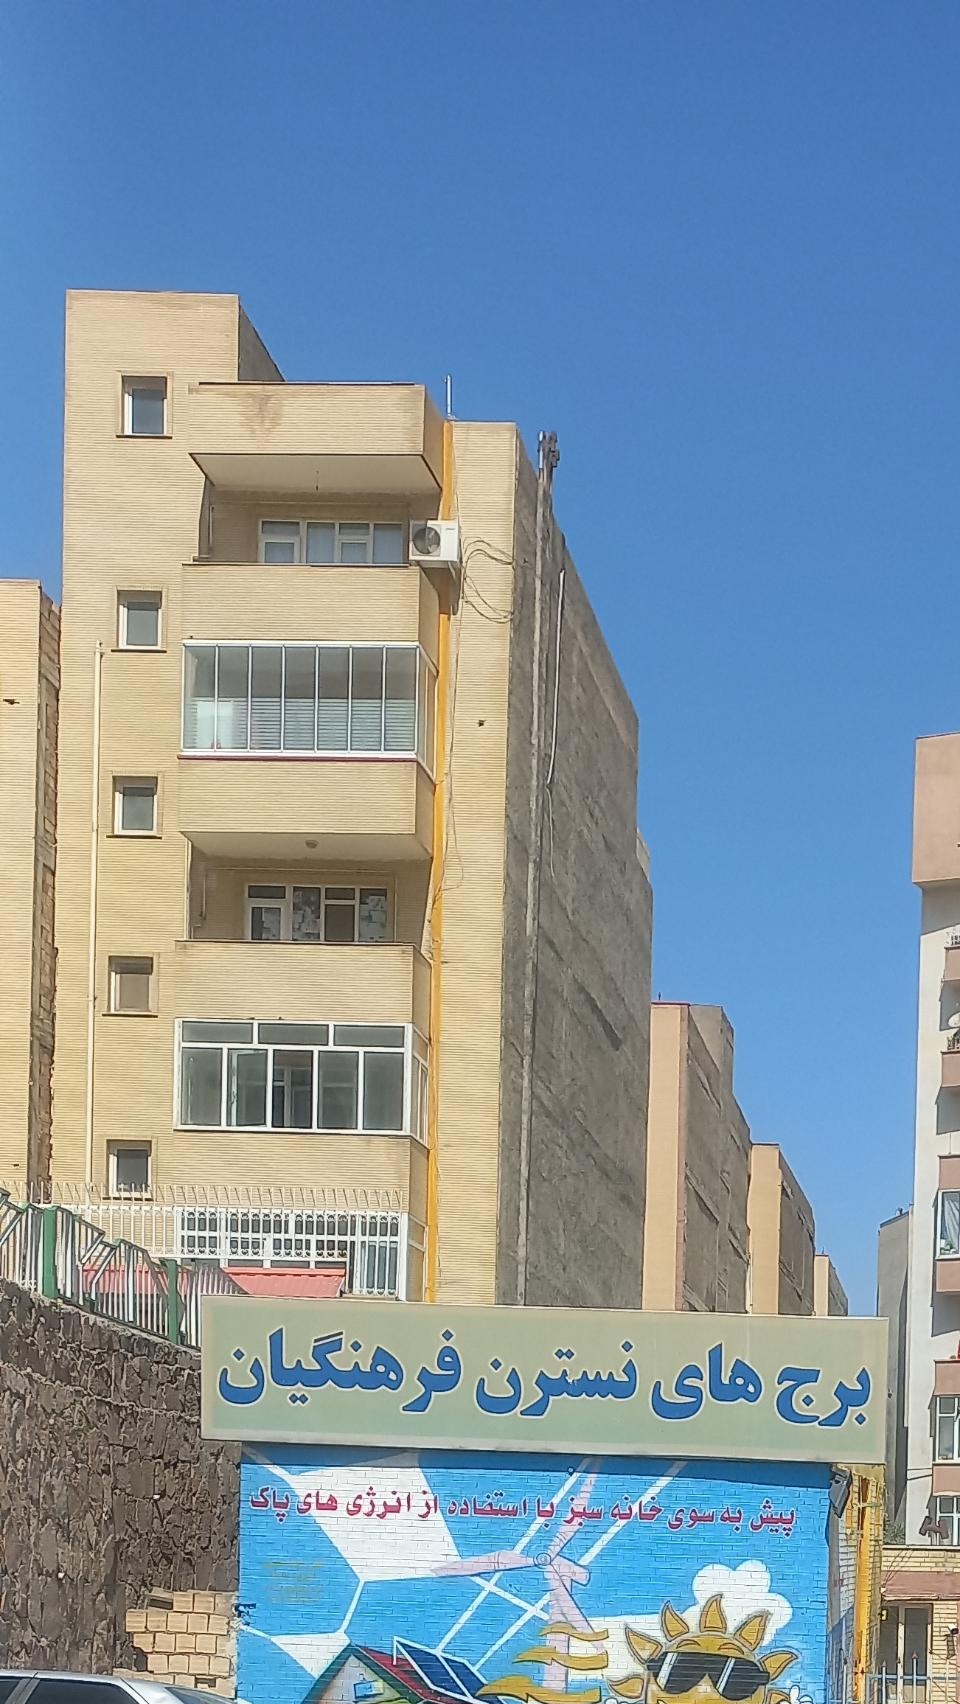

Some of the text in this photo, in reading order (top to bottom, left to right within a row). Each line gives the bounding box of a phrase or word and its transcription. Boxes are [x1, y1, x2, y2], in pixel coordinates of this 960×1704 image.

[217, 1328, 872, 1427] برج های نسترن فرهنگیان
[250, 1485, 796, 1537] پیش به سوی خانه سبز با استفاده از انرژی های پاک
